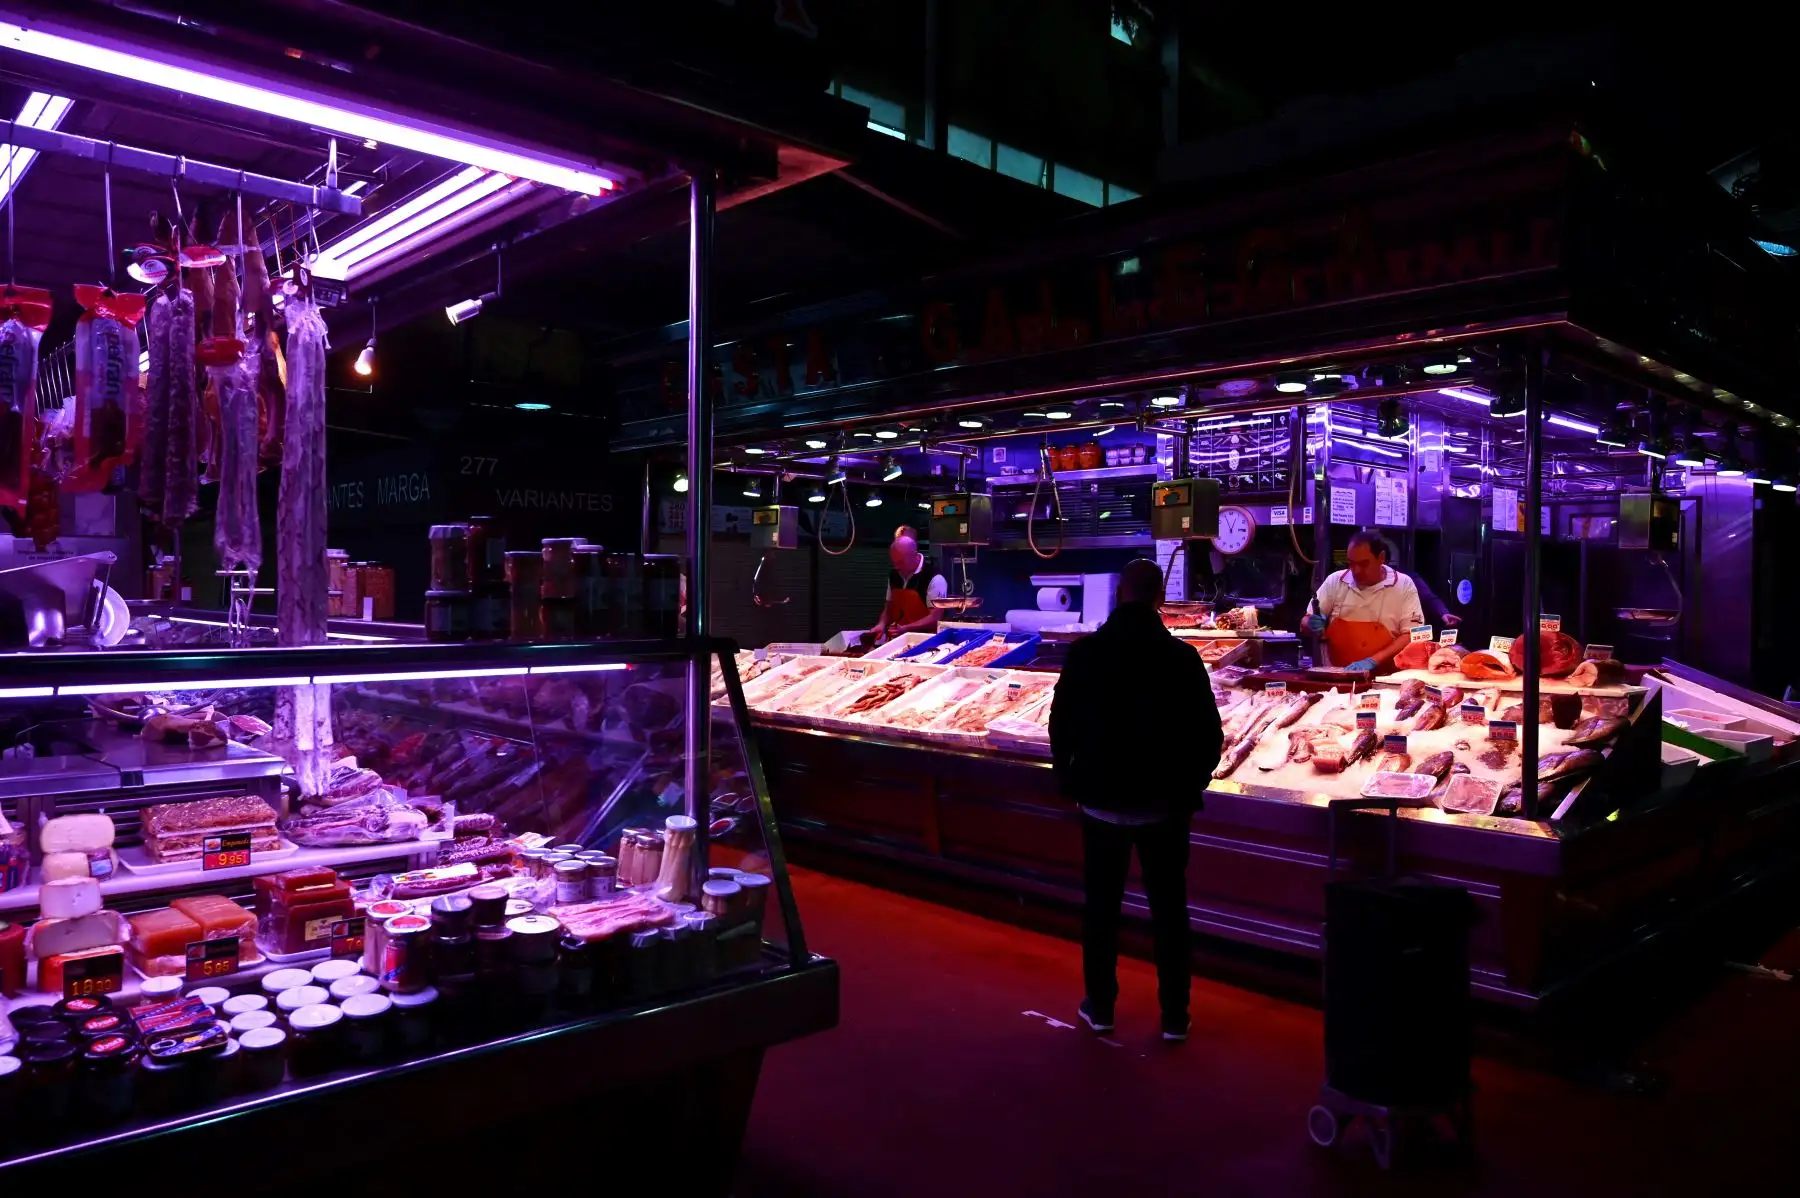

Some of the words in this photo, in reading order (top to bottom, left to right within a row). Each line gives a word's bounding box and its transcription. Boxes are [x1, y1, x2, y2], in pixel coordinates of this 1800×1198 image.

[460, 455, 499, 477] 277
[377, 470, 431, 506] MARGA
[495, 488, 614, 514] VARIANTES
